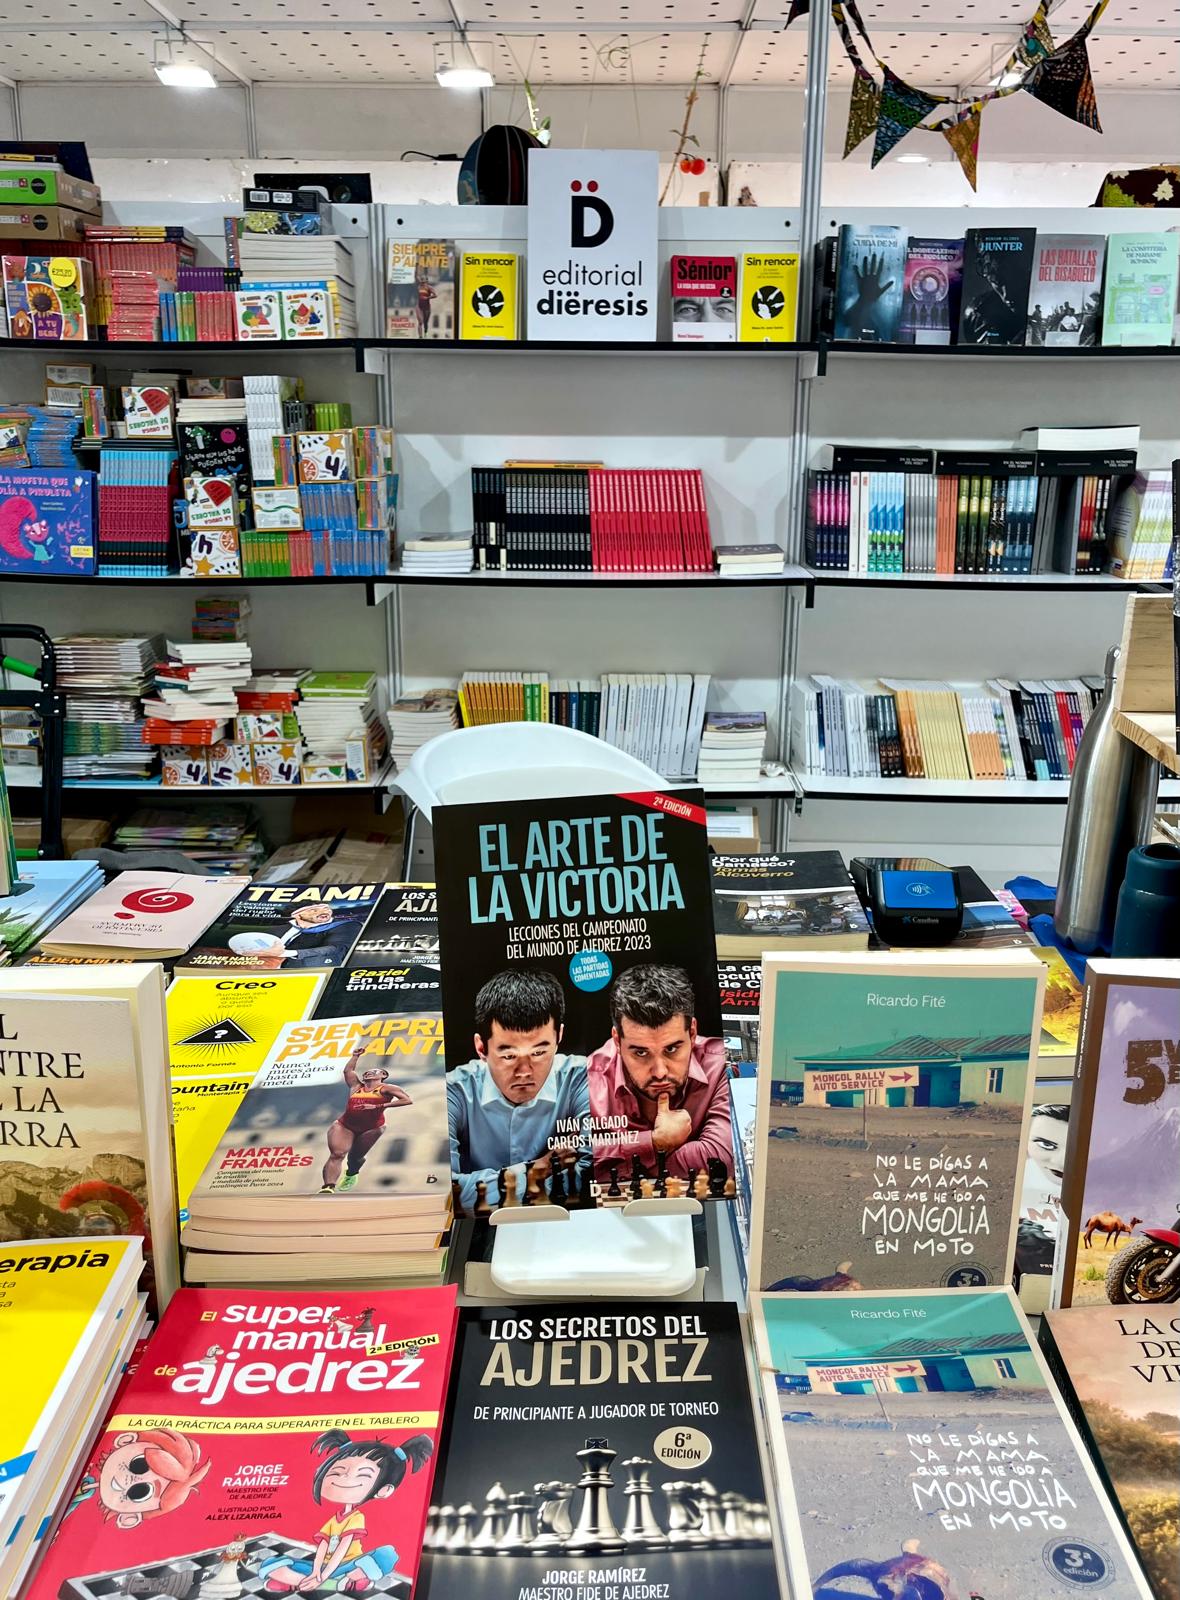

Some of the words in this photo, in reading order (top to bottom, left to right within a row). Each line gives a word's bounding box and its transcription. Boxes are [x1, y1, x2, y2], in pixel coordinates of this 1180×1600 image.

[393, 243, 446, 254] SIEMPRE
[980, 242, 1023, 251] HUNTER
[465, 257, 480, 265] Sin
[483, 258, 514, 266] rencor
[746, 257, 761, 266] Sin
[1040, 250, 1055, 266] LAS
[1058, 250, 1097, 266] BATALLAS
[543, 261, 643, 286] editorial
[678, 258, 732, 280] Sénior
[1039, 267, 1053, 281] DEL
[1055, 267, 1095, 282] BISABUELO
[536, 291, 648, 317] diëresis
[38, 320, 44, 328] A
[325, 456, 340, 476] 4
[0, 476, 11, 484] LA
[186, 763, 200, 782] 4
[279, 762, 292, 781] 4
[663, 798, 692, 816] EDICIÓN
[479, 824, 518, 872] EL
[525, 816, 614, 869] ARTE
[621, 813, 667, 862] DE
[248, 886, 375, 902] TEAM!
[402, 892, 425, 900] LOS
[468, 875, 513, 923] LA
[520, 862, 685, 919] VICTORIA
[509, 924, 560, 942] LECCIONES
[563, 922, 580, 938] DEL
[583, 918, 646, 936] CAMPEONATO
[506, 944, 524, 959] DEL
[526, 940, 564, 957] MUNDO
[567, 940, 579, 954] DE
[582, 936, 622, 953] AJEDREZ
[624, 934, 651, 951] 2023
[572, 966, 582, 974] LAS
[583, 961, 609, 972] PARTIDAS
[580, 955, 598, 965] TODAS
[348, 976, 370, 984] En
[350, 968, 410, 977] Gaziel
[574, 969, 610, 982] COMENTADAS
[215, 980, 277, 990] Creo
[346, 980, 440, 991] trincheras
[719, 980, 741, 988] de
[867, 993, 918, 1008] Ricardo
[922, 994, 946, 1008] Fité
[812, 1073, 852, 1083] MONGOL
[814, 1082, 839, 1091] AUTO
[841, 1080, 884, 1090] SERVICE
[14, 1086, 64, 1113] LA
[556, 1117, 580, 1133] IVÁN
[583, 1115, 628, 1130] SALGADO
[547, 1135, 586, 1150] CARLOS
[588, 1130, 639, 1147] MARTÍNEZ
[226, 1146, 294, 1158] MARTA
[220, 1154, 314, 1169] FRANCÉS
[873, 1172, 897, 1188] LA
[911, 1175, 988, 1188] MAMA
[872, 1190, 899, 1201] QUE
[904, 1191, 927, 1201] ME
[934, 1192, 946, 1203] HE
[976, 1194, 985, 1202] A
[875, 1239, 899, 1255] EN
[200, 1312, 217, 1322] El
[221, 1305, 340, 1329] super
[850, 1309, 900, 1319] Ricardo
[903, 1308, 927, 1318] Fité
[489, 1319, 532, 1340] LOS
[539, 1316, 656, 1339] SECRETOS
[664, 1316, 706, 1337] DEL
[1114, 1318, 1165, 1335] LA
[232, 1324, 386, 1350] manual
[385, 1336, 436, 1352] EDICIÓN
[480, 1338, 712, 1387] AJEDREZ
[154, 1364, 178, 1376] de
[172, 1351, 424, 1405] ajedrez
[819, 1374, 845, 1383] AUTO
[847, 1370, 890, 1381] SERVICE
[474, 1406, 489, 1420] DE
[493, 1406, 574, 1421] PRINCIPIANTE
[577, 1406, 586, 1419] A
[589, 1403, 646, 1419] JUGADOR
[650, 1403, 666, 1417] DE
[669, 1401, 719, 1416] TORNEO
[128, 1419, 142, 1427] LA
[145, 1417, 173, 1428] GUÍA
[175, 1418, 231, 1430] PRÁCTICA
[265, 1420, 333, 1430] SUPERARTE
[335, 1419, 351, 1427] EN
[353, 1418, 366, 1426] EL
[368, 1416, 419, 1426] TABLERO
[674, 1432, 692, 1448] 6ª
[661, 1448, 700, 1460] EDICIÓN
[909, 1449, 940, 1462] LA
[956, 1449, 1049, 1462] MAMA
[235, 1464, 284, 1476] JORGE
[222, 1473, 288, 1487] RAMÍREZ
[231, 1512, 282, 1520] LIZARRAGA
[940, 1514, 972, 1531] EN
[542, 1569, 585, 1584] JORGE
[588, 1566, 646, 1584] RAMÍREZ
[1063, 1567, 1098, 1578] edición
[519, 1587, 573, 1600] MAESTRO
[577, 1586, 601, 1600] FIDE
[604, 1586, 619, 1600] DE
[623, 1584, 670, 1600] AJEDREZ
